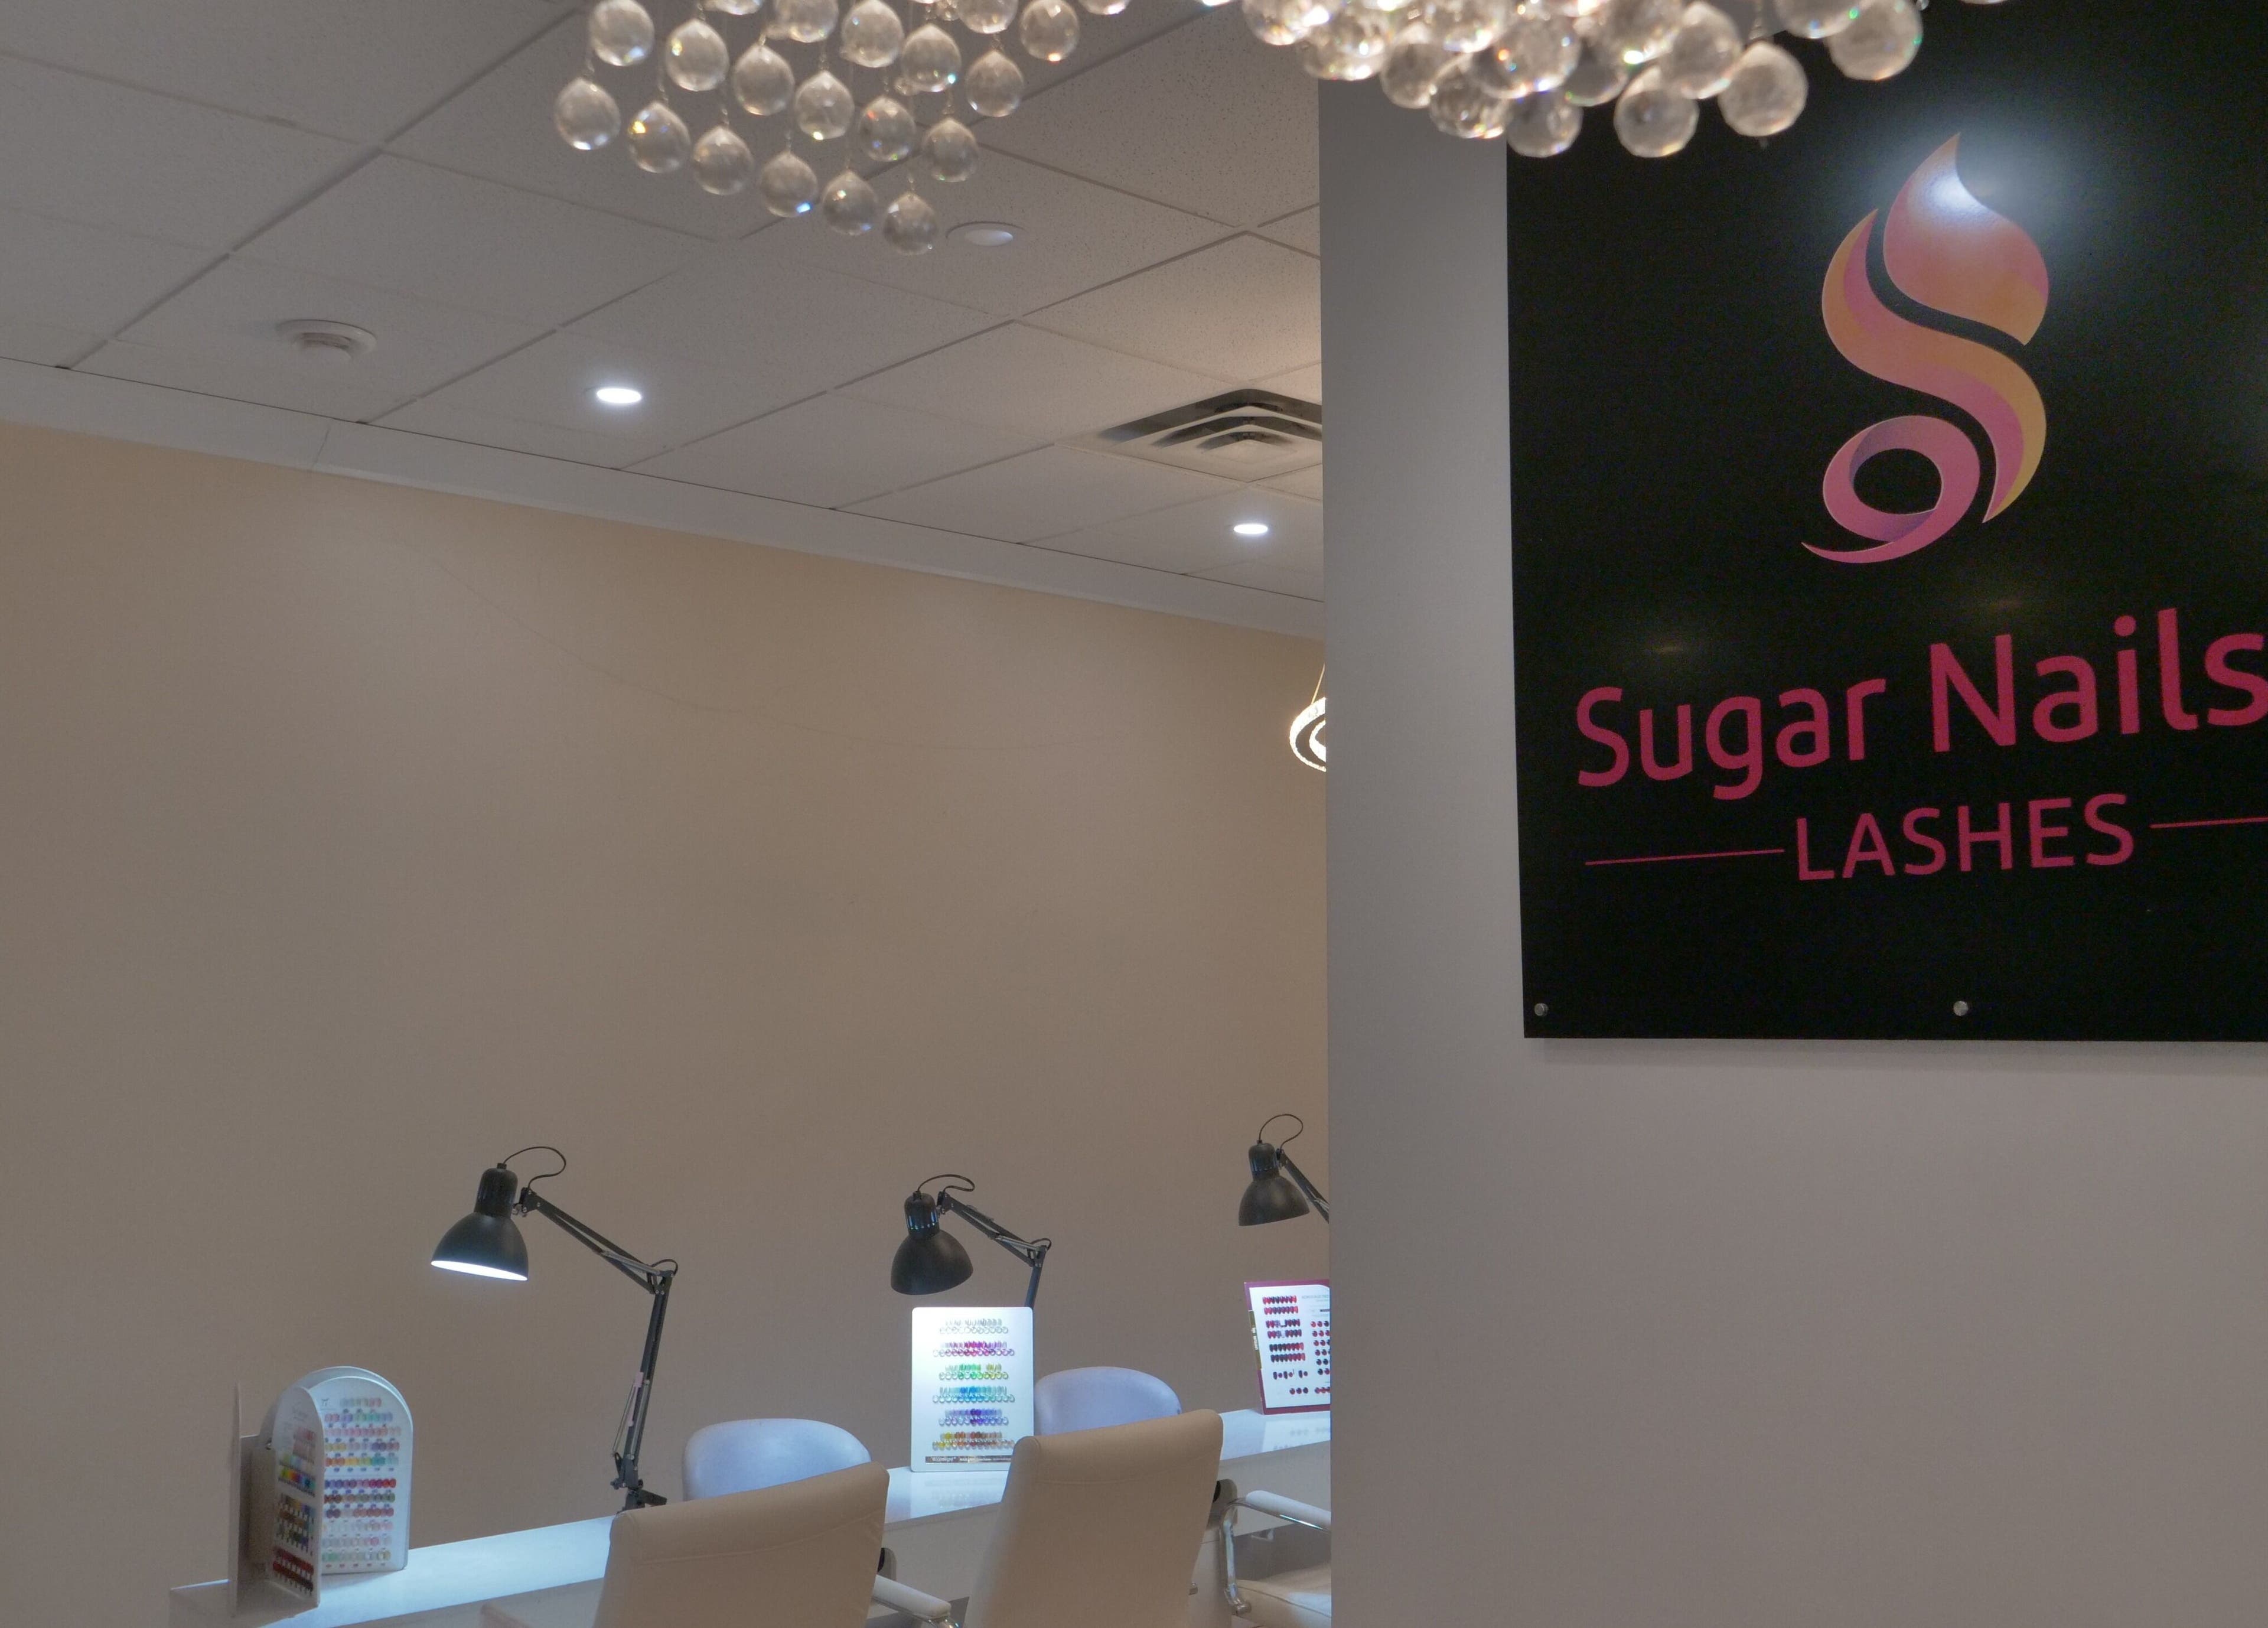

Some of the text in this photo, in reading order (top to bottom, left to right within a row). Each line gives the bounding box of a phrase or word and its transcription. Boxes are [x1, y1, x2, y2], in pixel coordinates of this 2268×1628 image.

[1576, 608, 2268, 800] Sugar Nails
[1797, 793, 2134, 880] LASHES
